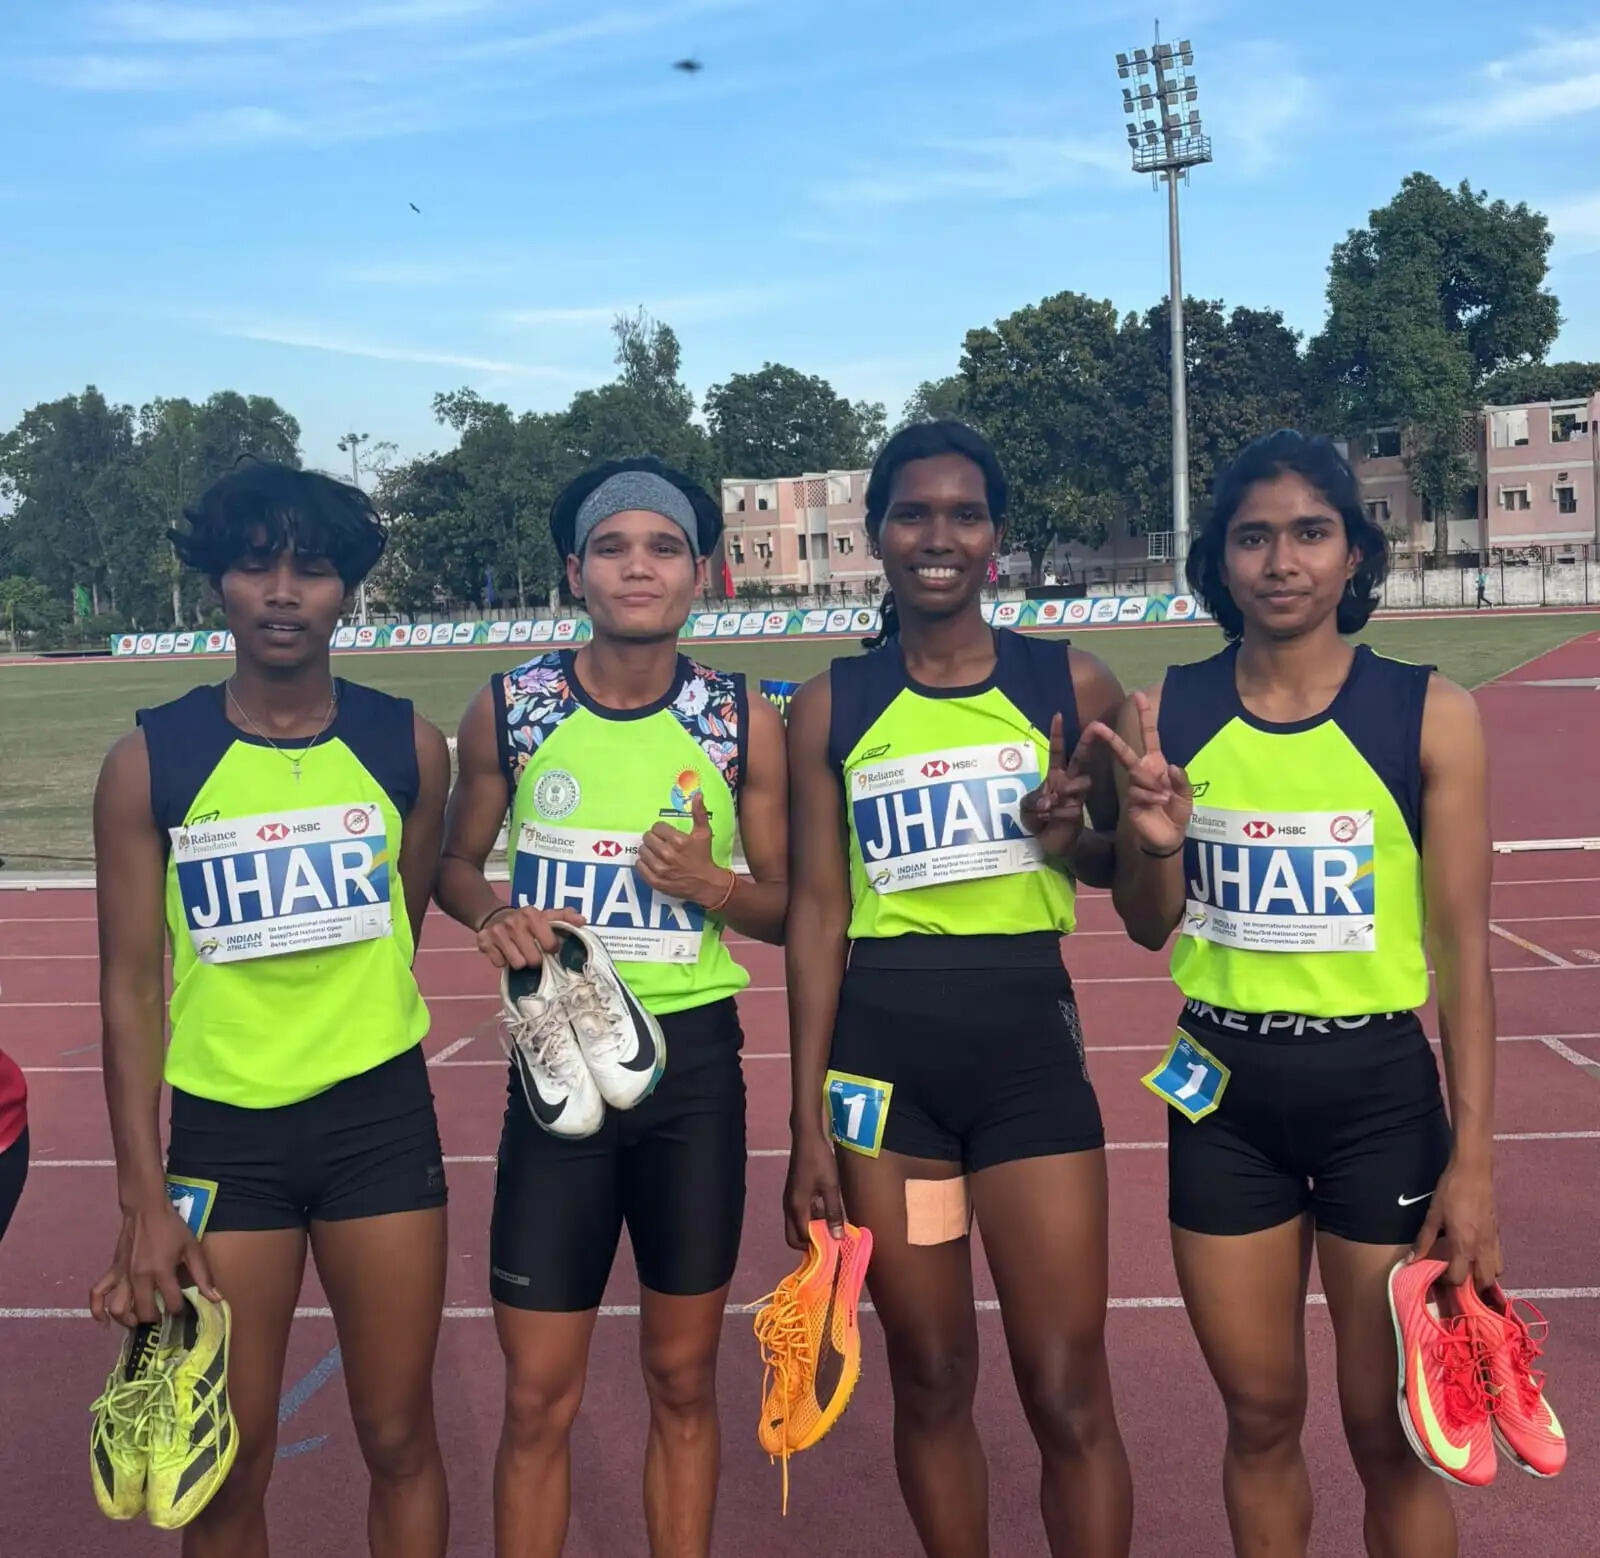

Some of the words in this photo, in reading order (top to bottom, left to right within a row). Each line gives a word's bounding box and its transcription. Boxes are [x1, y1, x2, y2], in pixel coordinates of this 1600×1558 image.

[952, 760, 978, 770] HSBC
[868, 768, 905, 783] Reliance
[866, 777, 1033, 860] JHAR
[1192, 814, 1227, 828] Reliance
[293, 822, 321, 834] HSBC
[1278, 826, 1307, 835] HSBC
[191, 831, 237, 845] Reliance
[534, 832, 576, 847] Reliance
[192, 841, 238, 854] Foundation
[625, 846, 638, 855] HS
[897, 862, 927, 874] INDIAN
[191, 840, 380, 928] JHAR
[1190, 842, 1363, 914] JHAR
[226, 931, 262, 945] INDIAN
[227, 941, 263, 952] ATHLETICS
[1174, 1062, 1208, 1100] 1
[843, 1093, 867, 1140] 1
